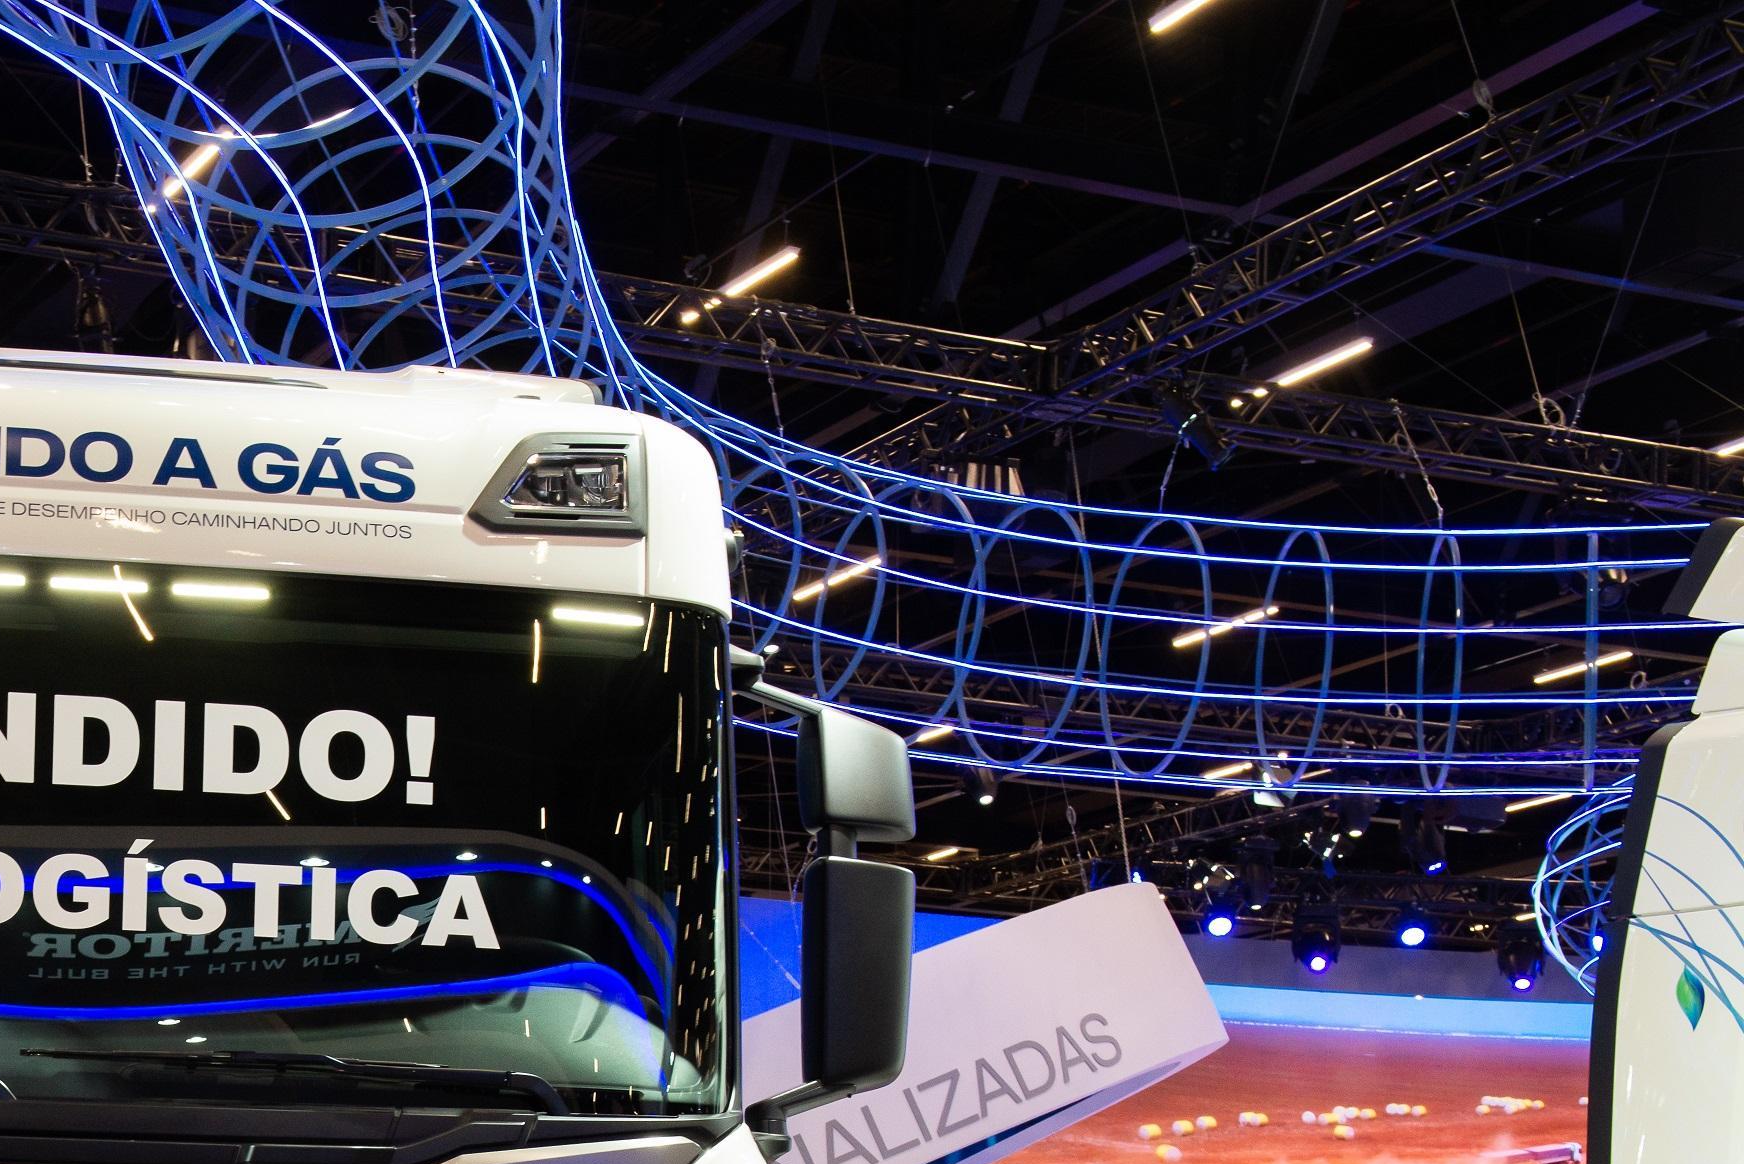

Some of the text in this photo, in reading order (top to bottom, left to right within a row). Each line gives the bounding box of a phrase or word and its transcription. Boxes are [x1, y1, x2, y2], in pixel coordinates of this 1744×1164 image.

[152, 437, 218, 489] A
[237, 437, 416, 503] GÁS
[11, 501, 166, 525] DESEMPENHO
[171, 511, 321, 534] CAMINHANDO
[325, 521, 413, 539] JUNTOS
